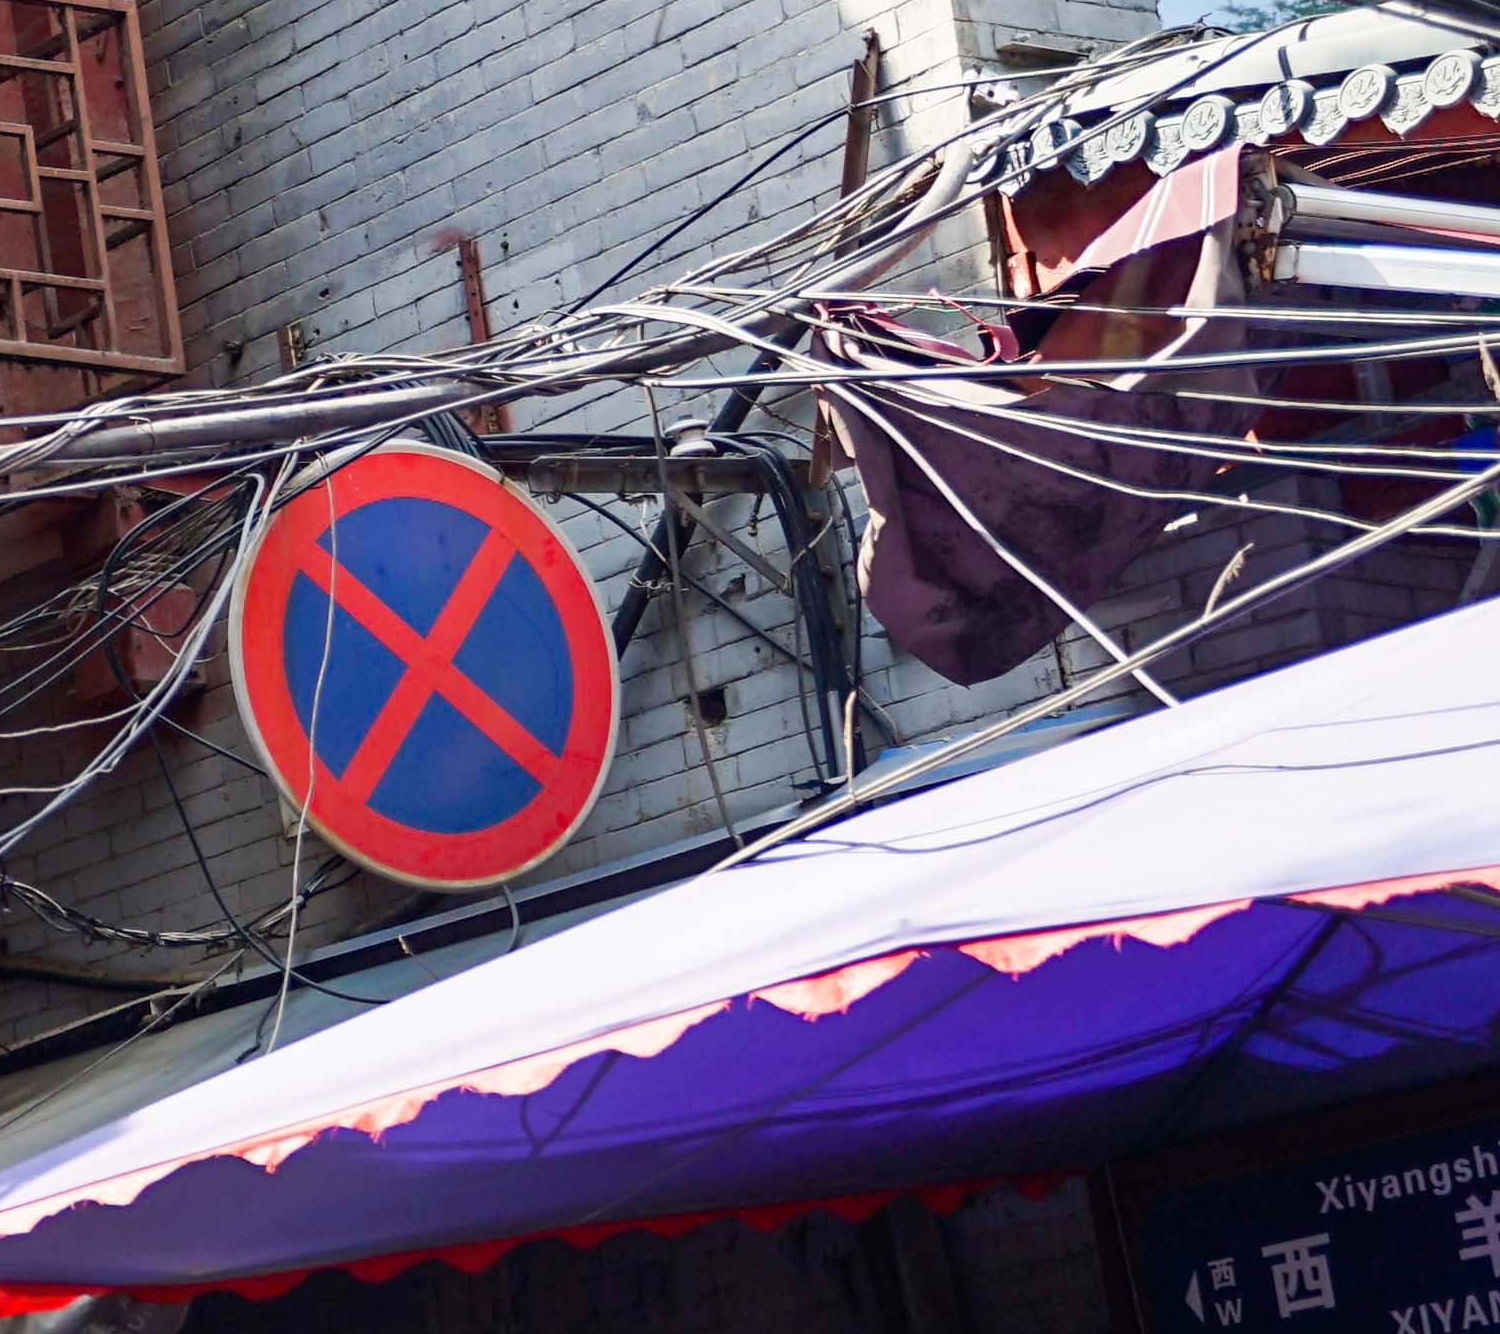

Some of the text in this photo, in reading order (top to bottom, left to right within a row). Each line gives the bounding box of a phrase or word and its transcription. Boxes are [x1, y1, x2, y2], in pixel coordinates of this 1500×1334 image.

[1315, 1142, 1500, 1214] Xiyangsh
[1208, 1257, 1236, 1290] 西
[1215, 1298, 1243, 1326] W
